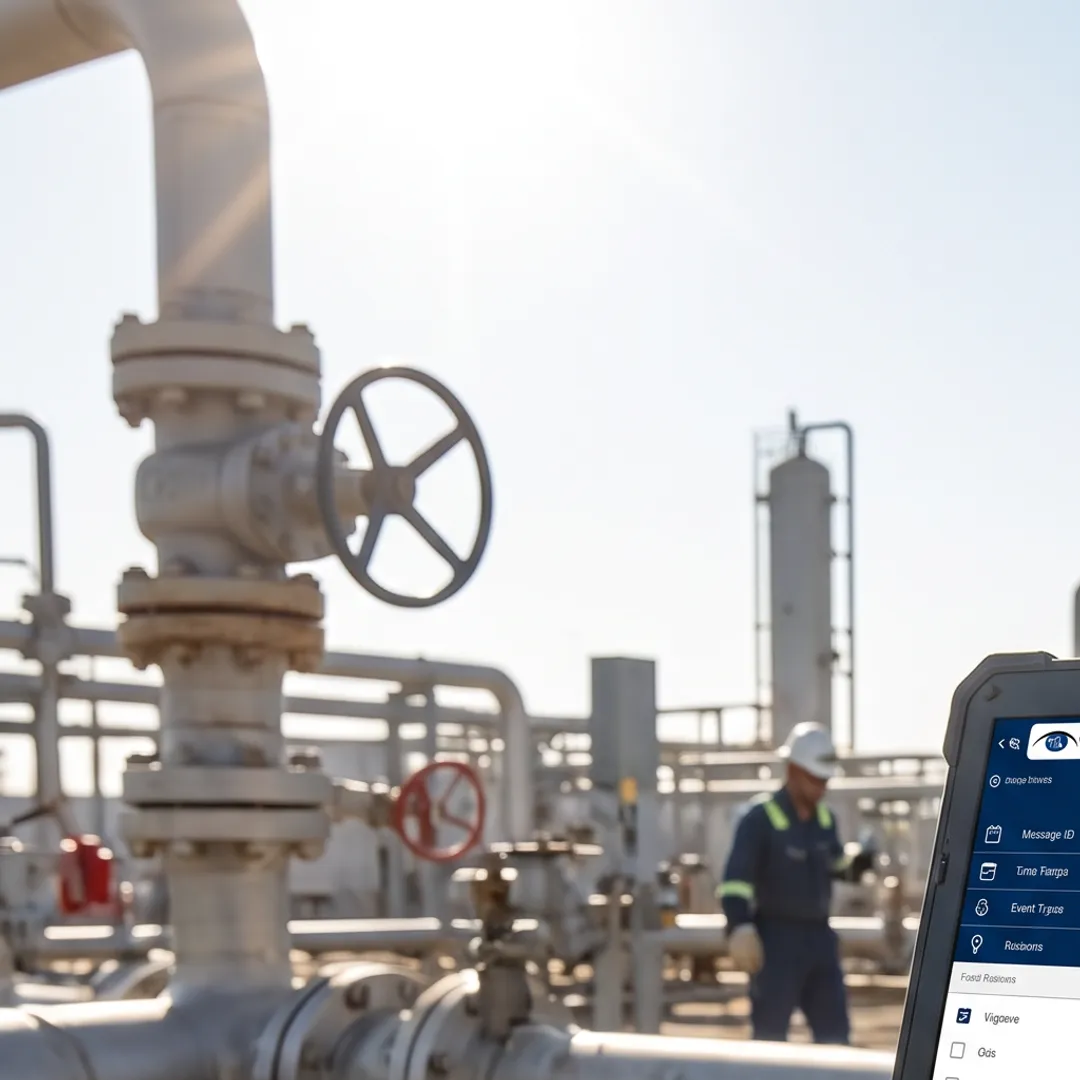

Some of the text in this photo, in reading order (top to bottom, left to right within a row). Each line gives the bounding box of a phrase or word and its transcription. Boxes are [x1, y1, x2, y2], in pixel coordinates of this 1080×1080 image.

[1022, 829, 1075, 842] Message ID
[1011, 902, 1036, 914] Event
